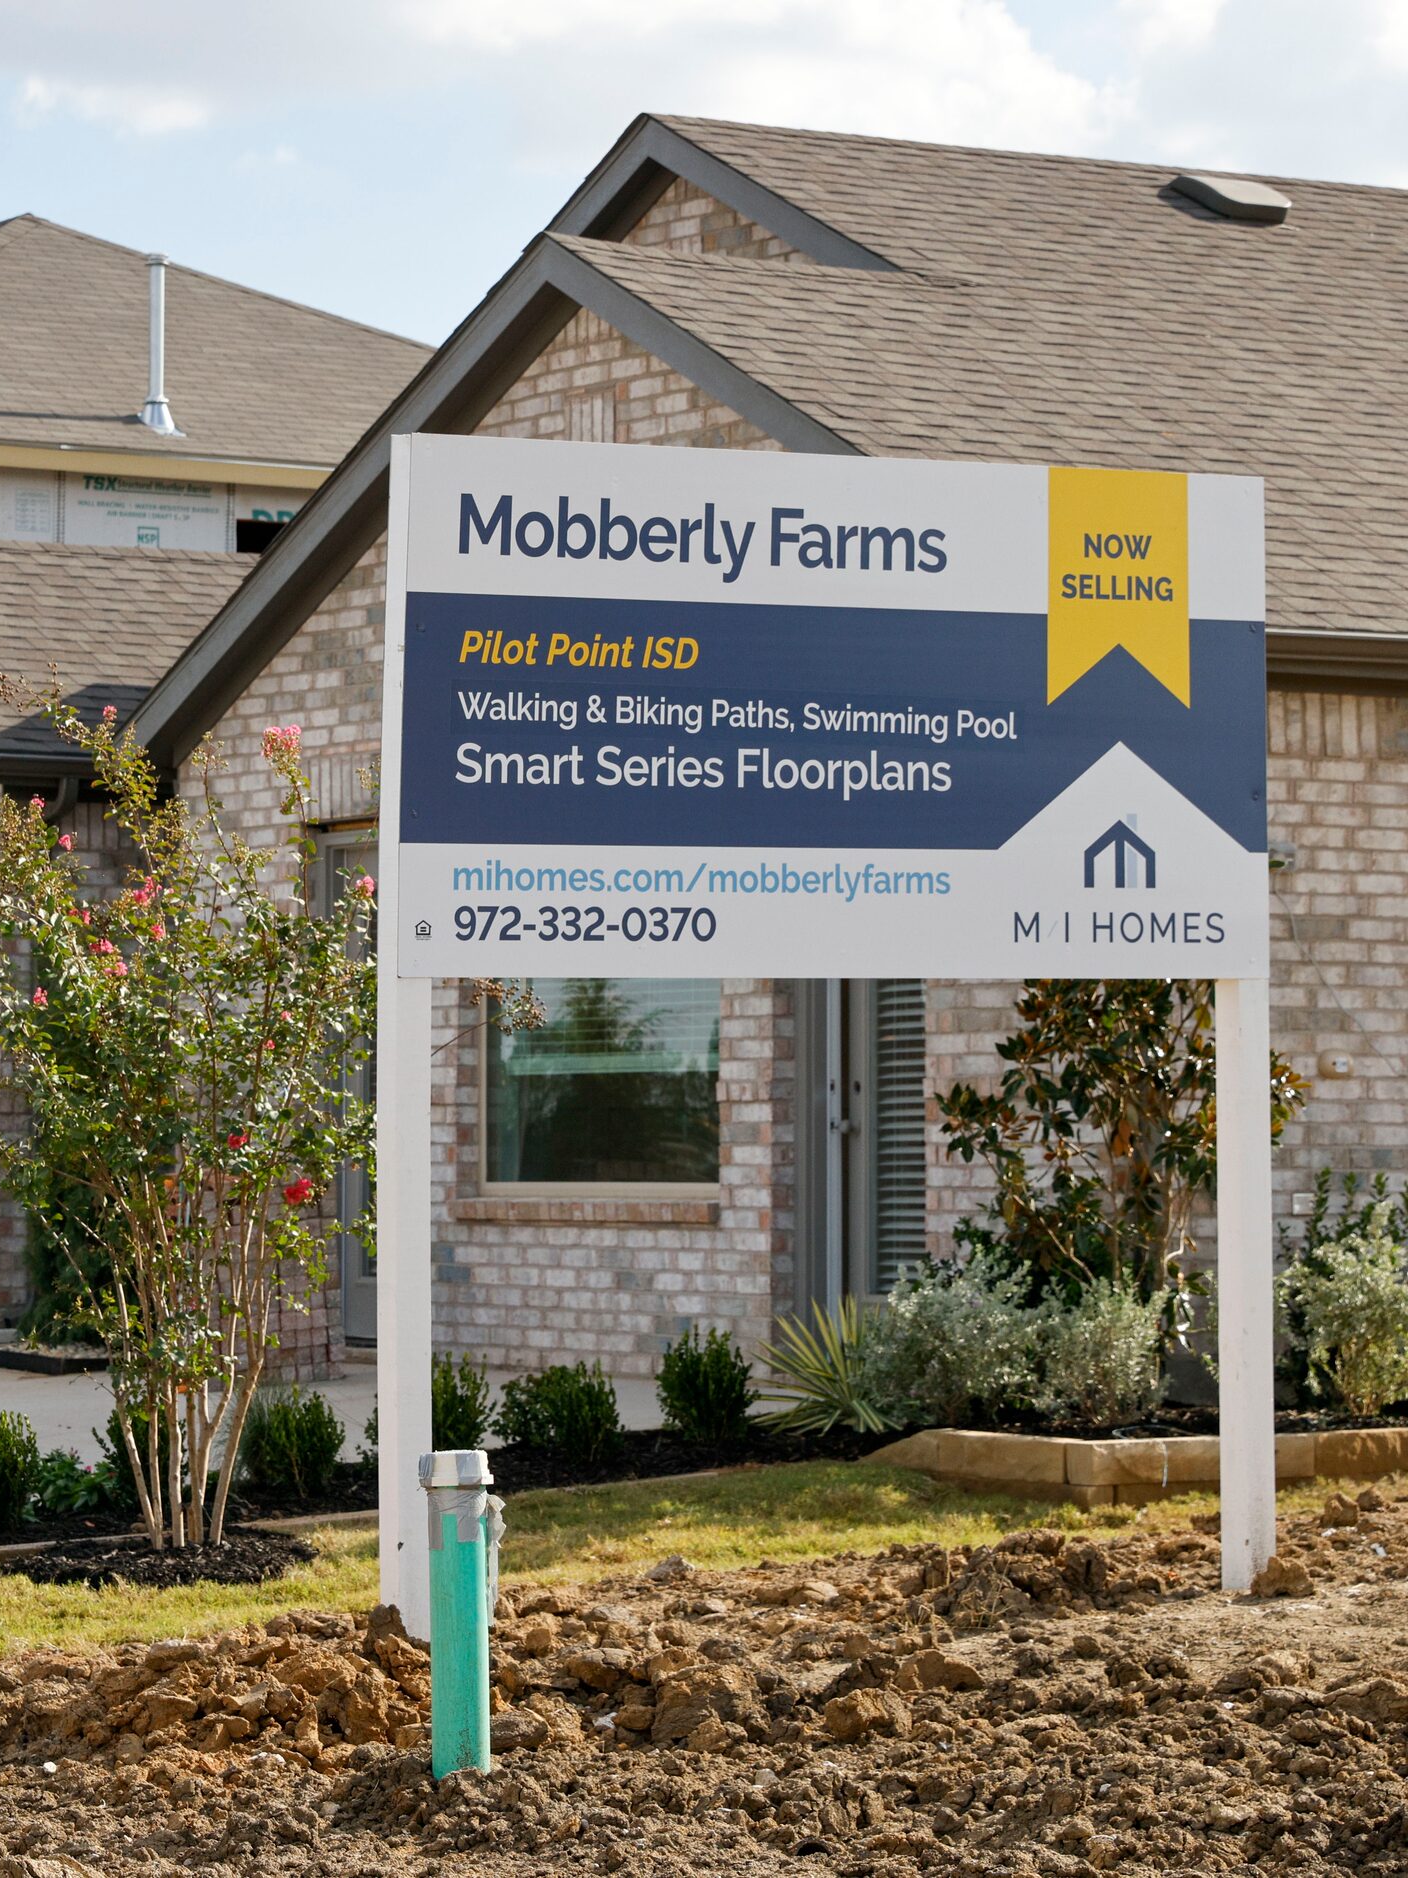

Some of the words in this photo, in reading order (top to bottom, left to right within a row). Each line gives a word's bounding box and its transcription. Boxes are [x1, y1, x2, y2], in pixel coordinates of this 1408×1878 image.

[82, 474, 118, 491] TSX
[138, 533, 156, 545] NSP
[458, 493, 756, 584] Mobberly
[770, 506, 947, 574] Farms
[1083, 533, 1152, 560] NOW
[1061, 574, 1174, 602] SELLING
[459, 630, 538, 665] Pilot
[546, 633, 634, 668] Point
[641, 636, 699, 670] ISD
[458, 691, 578, 731] Walking
[586, 695, 607, 724] &
[615, 696, 703, 734] Biking
[711, 699, 795, 732] Paths,
[802, 702, 948, 743] Swimming
[957, 709, 1017, 740] Pool
[455, 742, 585, 786] Smart
[595, 745, 724, 788] Series
[737, 748, 952, 801] Floorplans
[453, 859, 951, 902] mihomes.com/mobberlyfarms
[454, 905, 717, 942] 972-332-0370
[1092, 912, 1225, 944] HOMES
